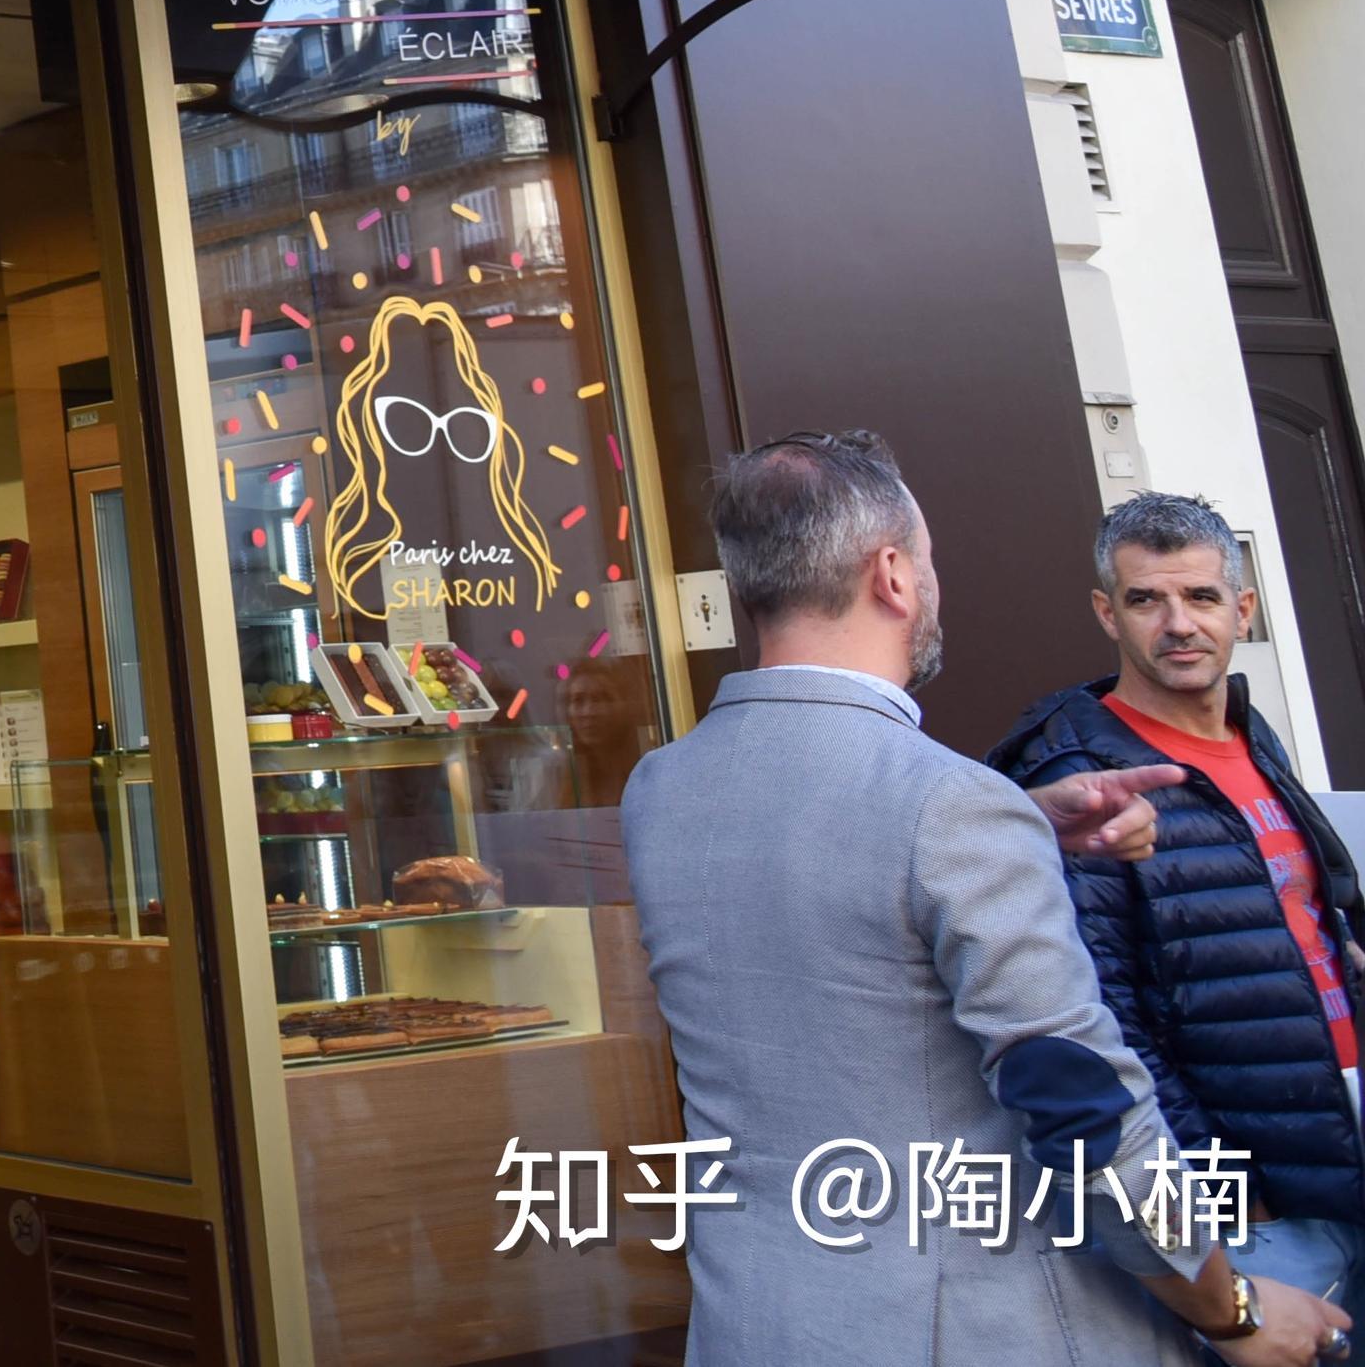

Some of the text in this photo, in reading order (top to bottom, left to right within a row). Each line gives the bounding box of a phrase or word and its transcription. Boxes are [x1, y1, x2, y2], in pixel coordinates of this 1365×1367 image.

[397, 27, 525, 62] ÉCLAIR
[376, 110, 421, 156] by
[388, 539, 514, 567] Paris chez
[388, 577, 516, 608] SHARON
